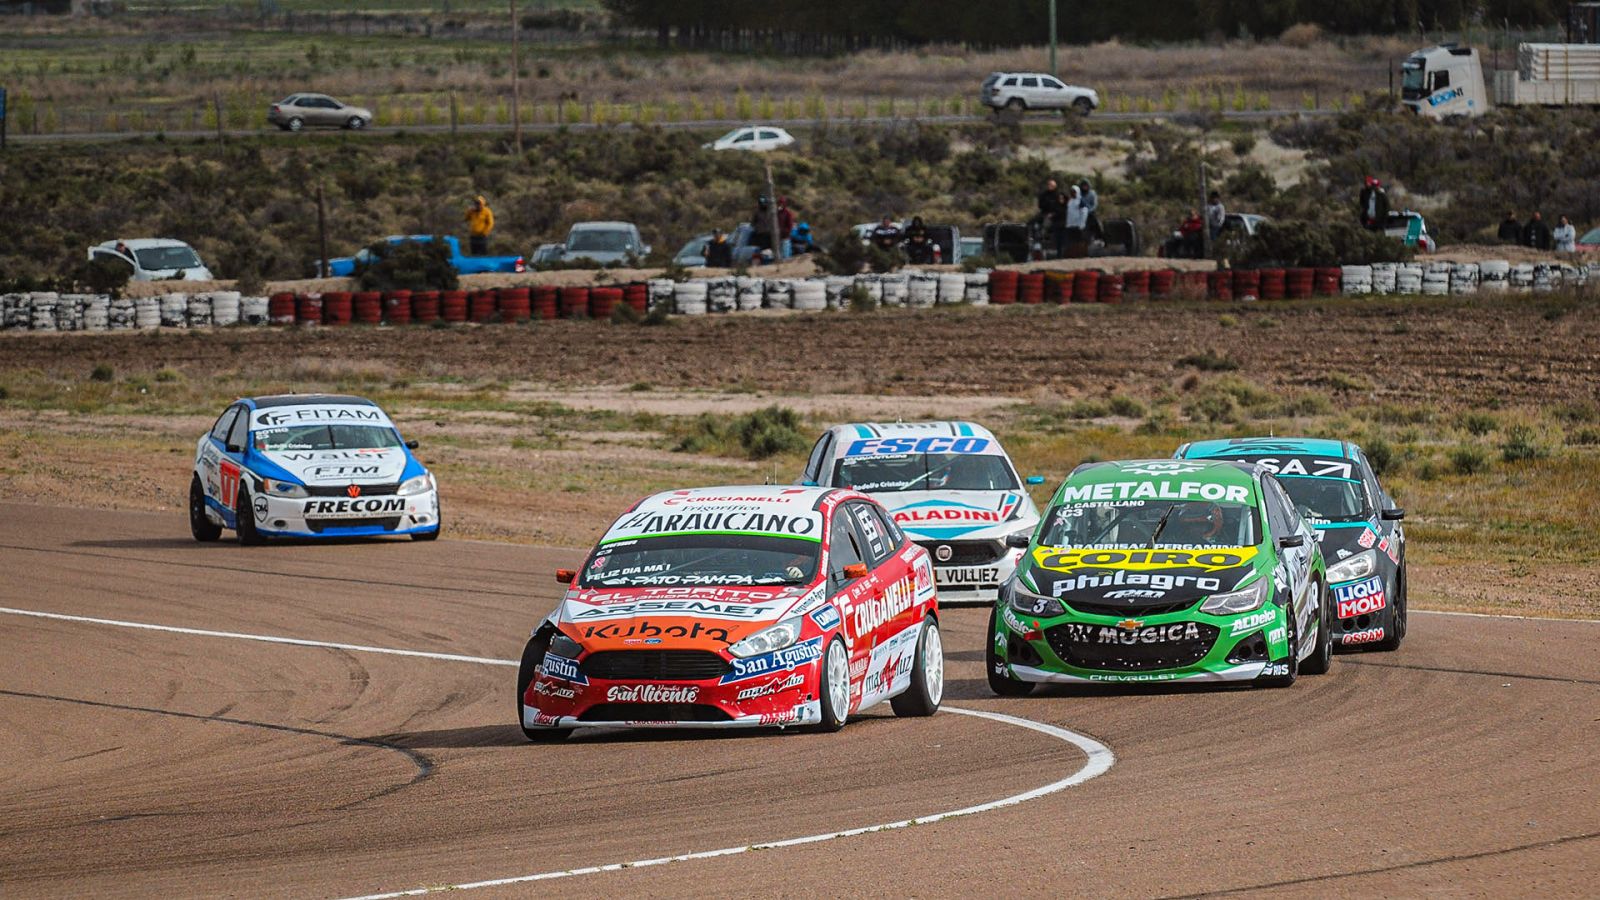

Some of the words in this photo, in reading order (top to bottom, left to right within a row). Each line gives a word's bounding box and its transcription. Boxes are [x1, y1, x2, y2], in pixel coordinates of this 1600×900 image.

[296, 409, 380, 420] FITAM
[845, 437, 990, 457] ESCO
[314, 466, 380, 476] FTM
[1064, 481, 1250, 503] METALFOR
[303, 498, 406, 513] FRECOM
[1063, 500, 1145, 509] J.CASTELLANO
[894, 509, 999, 522] ALADINI
[1062, 508, 1083, 518] C3
[642, 512, 815, 535] ARAUCANO
[1043, 551, 1242, 567] COIRO
[622, 565, 641, 576] DIA
[946, 568, 999, 584] VULLIEZ
[632, 575, 682, 586] PATO
[681, 574, 755, 585] PAMPA
[1053, 570, 1220, 598] philagro
[645, 587, 773, 600] TORITO
[1338, 578, 1381, 602] LIQUI
[577, 601, 775, 616] ARSEMET
[855, 575, 912, 639] CRUCIANELLI
[1033, 599, 1048, 613] 3
[1341, 593, 1384, 617] MOLY
[585, 621, 732, 643] Kubota
[1343, 628, 1384, 645] OSRAM
[733, 657, 769, 676] San
[607, 685, 638, 702] San
[634, 685, 698, 703] Vicente
